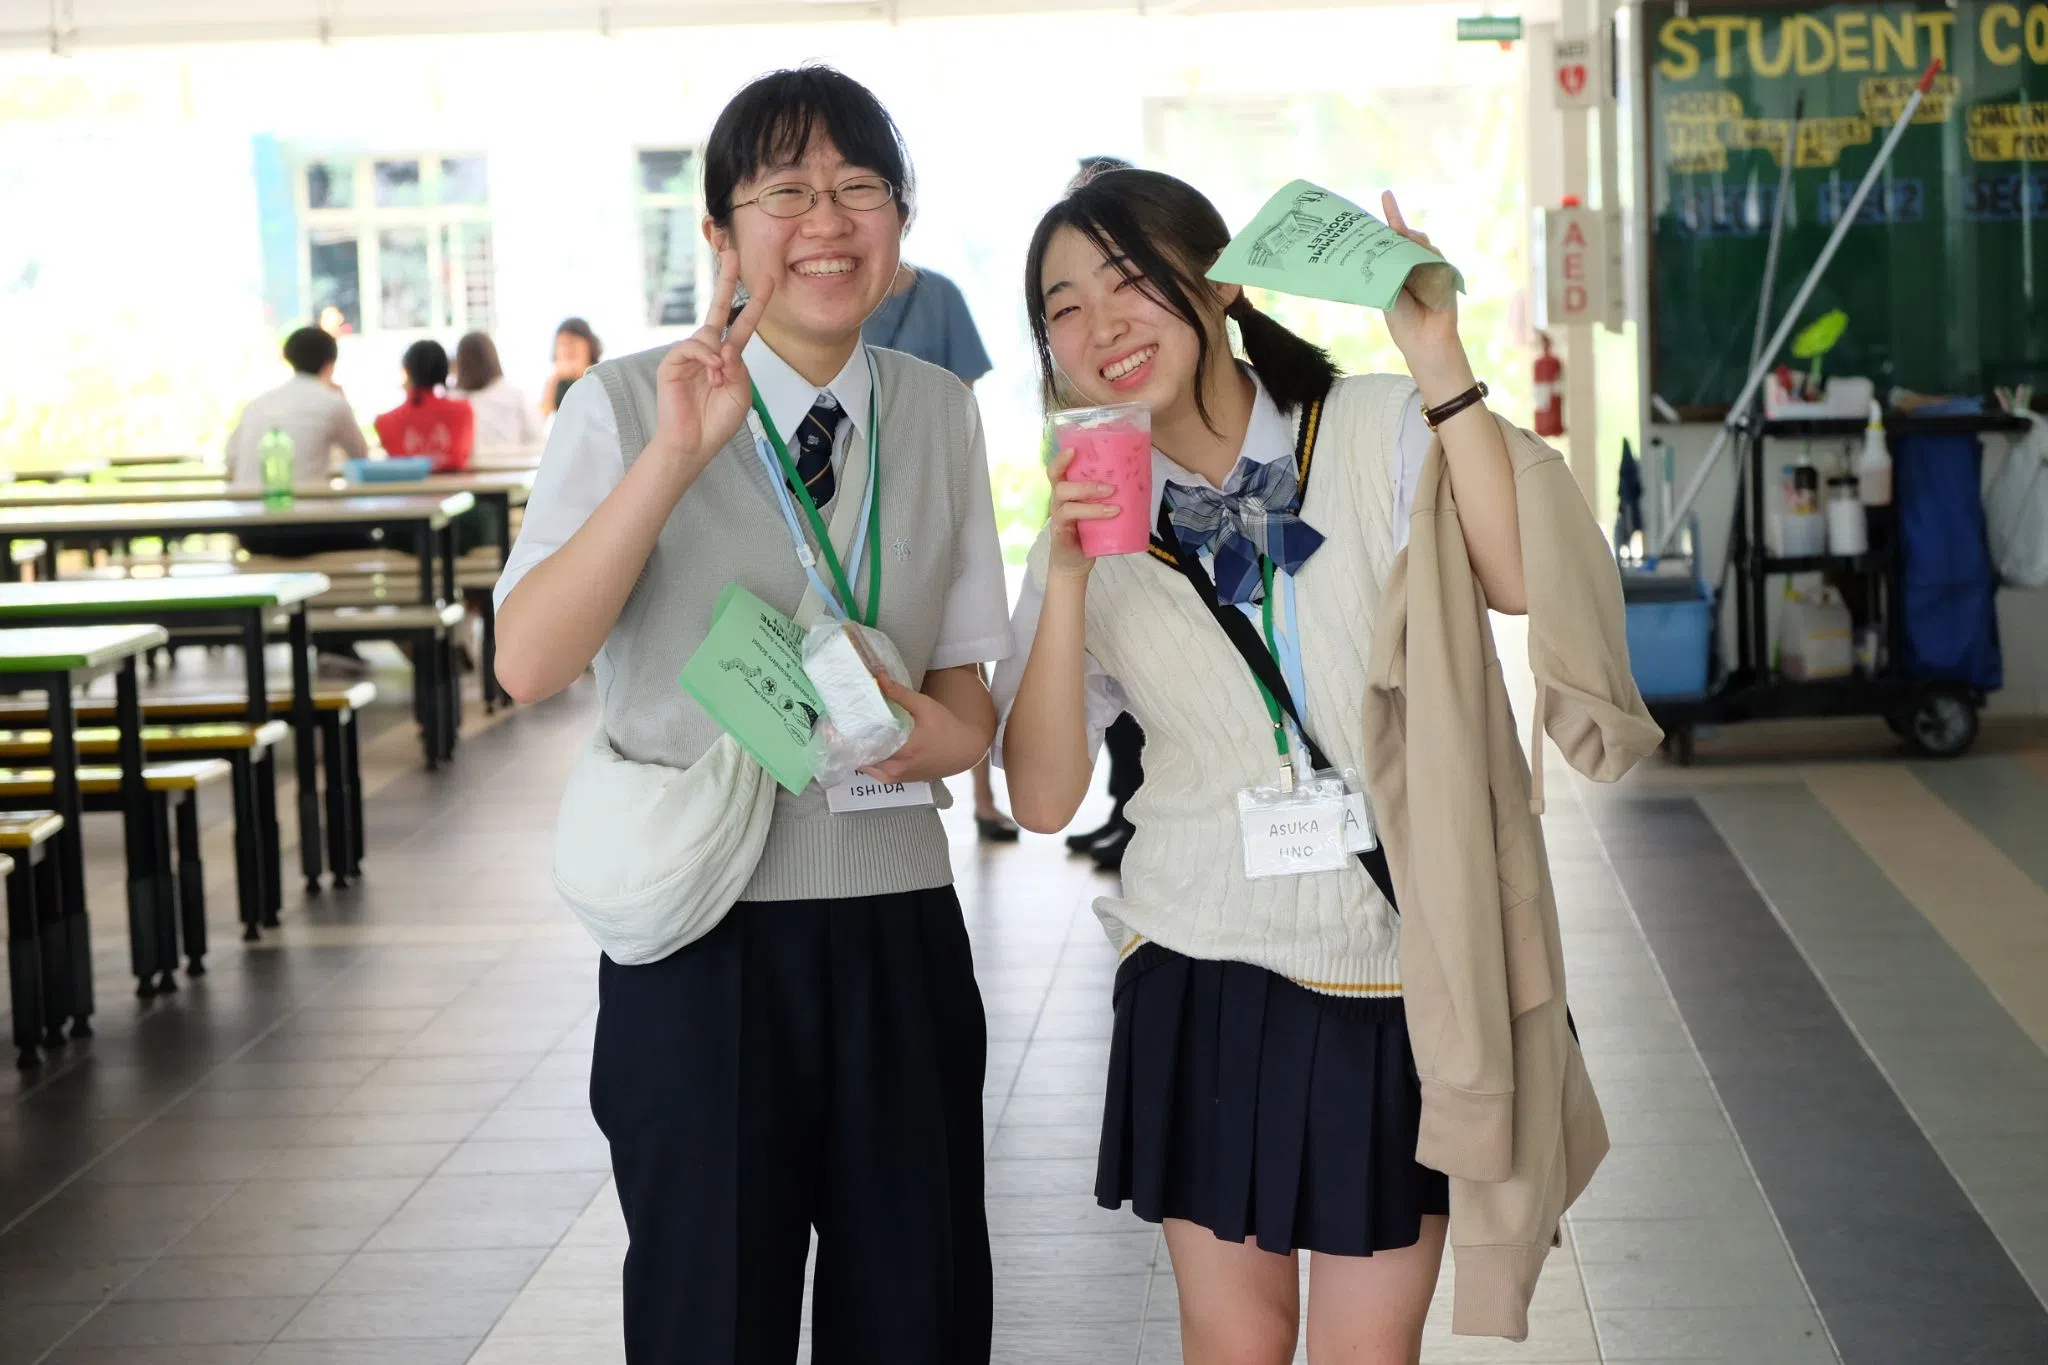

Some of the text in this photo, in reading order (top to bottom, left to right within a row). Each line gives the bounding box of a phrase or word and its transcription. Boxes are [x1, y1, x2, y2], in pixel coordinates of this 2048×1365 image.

[1658, 3, 2048, 80] STUDENT CO
[1307, 211, 1352, 251] BOOKLET
[1308, 210, 1368, 264] ROGRAMME
[1563, 220, 1587, 313] AED
[850, 782, 906, 797] ISHIDA
[1269, 819, 1320, 838] ASUKA
